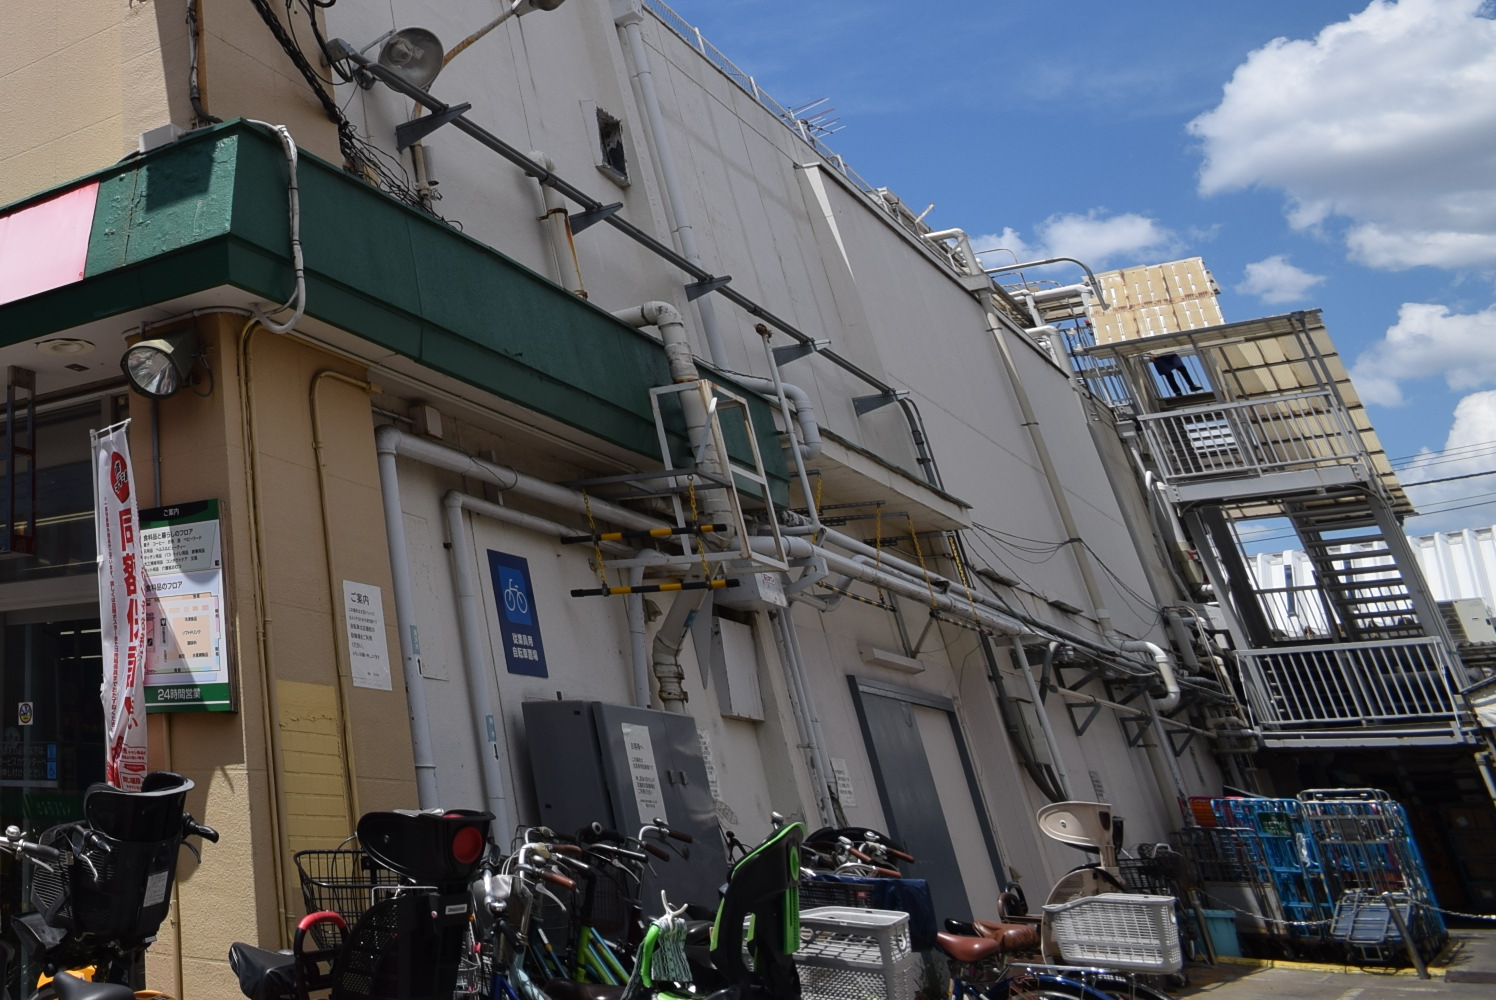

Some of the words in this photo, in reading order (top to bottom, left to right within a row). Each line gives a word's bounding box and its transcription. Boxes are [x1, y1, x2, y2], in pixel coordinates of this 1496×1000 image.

[163, 508, 180, 517] ご案内
[145, 581, 183, 592] 食料品のフロア
[350, 592, 370, 606] ご案内
[157, 688, 201, 700] 24時間営業
